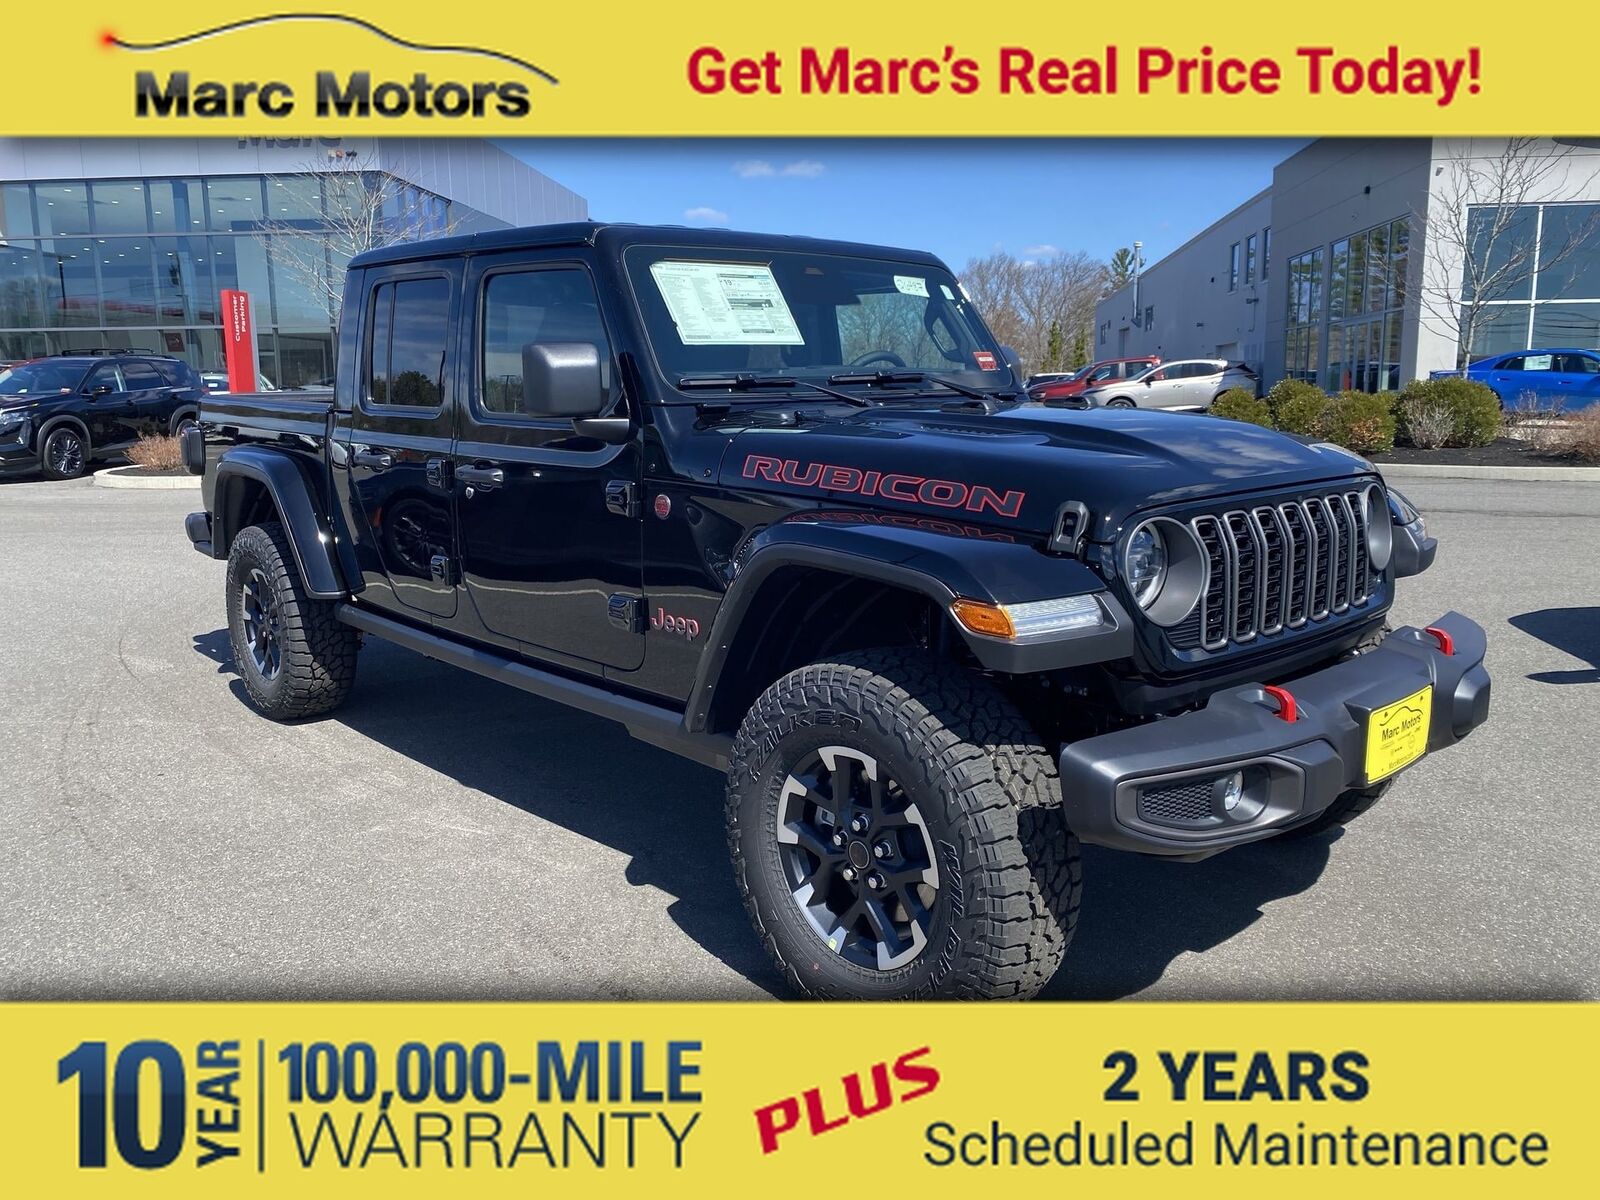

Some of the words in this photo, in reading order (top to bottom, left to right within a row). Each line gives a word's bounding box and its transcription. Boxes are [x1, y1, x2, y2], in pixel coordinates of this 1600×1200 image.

[232, 294, 241, 342] Customer
[239, 295, 247, 333] Parking
[742, 454, 1026, 518] RUBICON
[651, 607, 699, 641] Jeep
[1381, 726, 1400, 742] Marc
[1401, 714, 1421, 733] Motors
